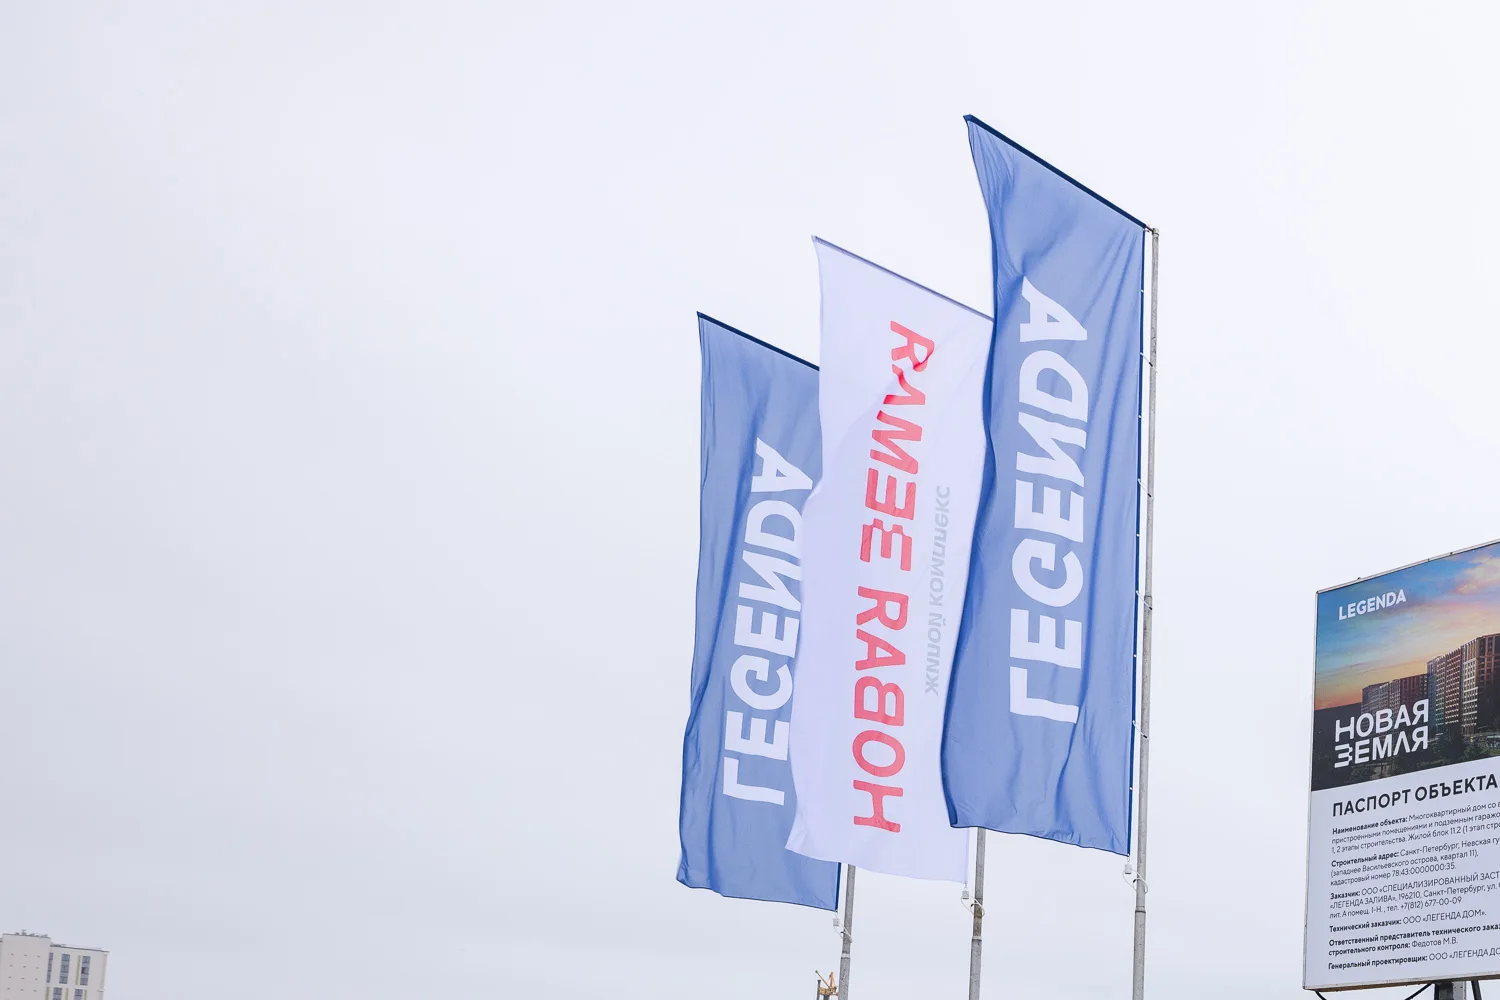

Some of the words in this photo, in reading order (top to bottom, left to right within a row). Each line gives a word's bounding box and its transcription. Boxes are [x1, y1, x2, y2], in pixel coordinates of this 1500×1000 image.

[1339, 589, 1408, 620] LEGENDA
[1335, 698, 1430, 743] НОВАЯ
[1334, 725, 1430, 768] ЗЕМЛЯ
[1332, 788, 1412, 817] ПАСПОРТ
[1414, 773, 1499, 802] ОБЪЕКТА
[1331, 831, 1381, 845] пристроенными
[1382, 823, 1427, 836] помещениями
[1434, 816, 1473, 827] подземным
[1332, 822, 1379, 835] Наименование
[1380, 817, 1407, 827] объекта:
[1408, 806, 1471, 821] Многоквартирный
[1472, 804, 1486, 812] дом
[1336, 845, 1341, 853] 2
[1341, 844, 1359, 852] этапы
[1407, 830, 1431, 841] Жилой
[1432, 829, 1449, 837] блок
[1462, 825, 1468, 834] (1
[1469, 824, 1485, 832] этап
[1330, 867, 1361, 878] (западнее
[1362, 860, 1409, 872] Васильевского
[1410, 855, 1439, 865] острова,
[1440, 851, 1468, 861] квартал
[1331, 855, 1377, 868] Строительный
[1378, 852, 1399, 860] адрес:
[1399, 842, 1460, 857] Санкт-Петербург,
[1461, 838, 1491, 848] Невская
[1330, 874, 1370, 886] кадастровый
[1370, 872, 1391, 880] номер
[1330, 891, 1360, 900] Заказчик:
[1361, 886, 1378, 896] ООО
[1330, 898, 1364, 909] «ЛЕГЕНДА
[1423, 884, 1486, 898] Санкт-Петербург,
[1400, 900, 1423, 911] +7(812)
[1424, 896, 1462, 907] 677-00-09
[1329, 921, 1370, 932] Технический
[1371, 919, 1401, 928] заказчик:
[1402, 915, 1421, 925] ООО
[1422, 911, 1461, 922] «ЛЕГЕНДА
[1328, 934, 1379, 946] Ответственный
[1379, 931, 1431, 942] представитель
[1431, 925, 1481, 936] технического
[1328, 946, 1376, 957] строительного
[1377, 942, 1410, 951] контроля:
[1411, 939, 1441, 948] Федотов
[1443, 936, 1458, 945] М.В.
[1328, 959, 1370, 970] Генеральный
[1371, 955, 1427, 967] проектировщик:
[1428, 951, 1448, 961] ООО
[1449, 948, 1489, 959] «ЛЕГЕНДА
